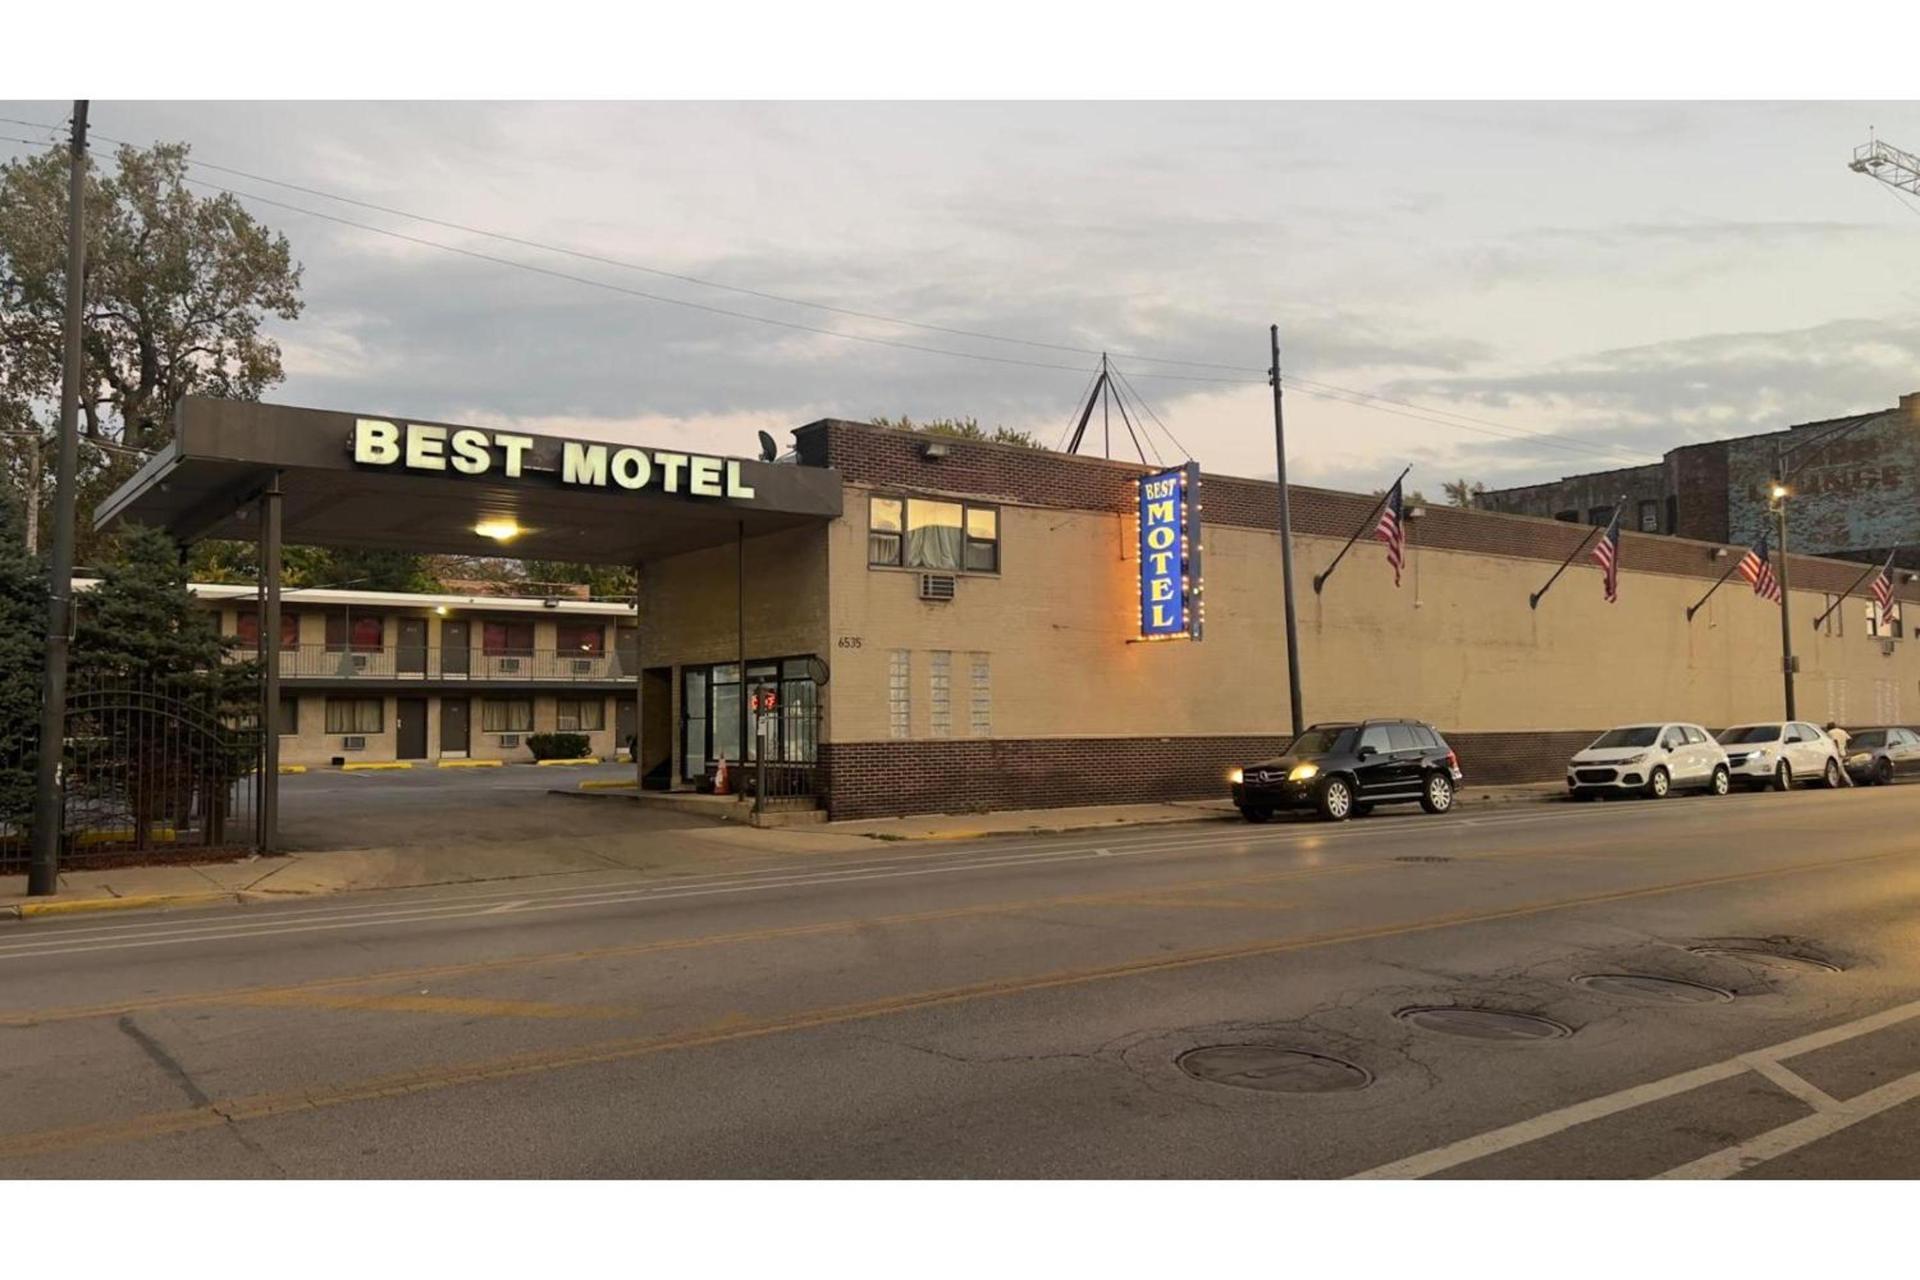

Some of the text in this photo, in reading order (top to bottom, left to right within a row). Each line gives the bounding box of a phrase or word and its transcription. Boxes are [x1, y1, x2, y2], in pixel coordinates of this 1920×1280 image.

[354, 418, 755, 499] BEST MOTEL
[1145, 478, 1177, 500] BEST
[1147, 500, 1175, 627] MOTEL
[838, 637, 862, 649] 6535
